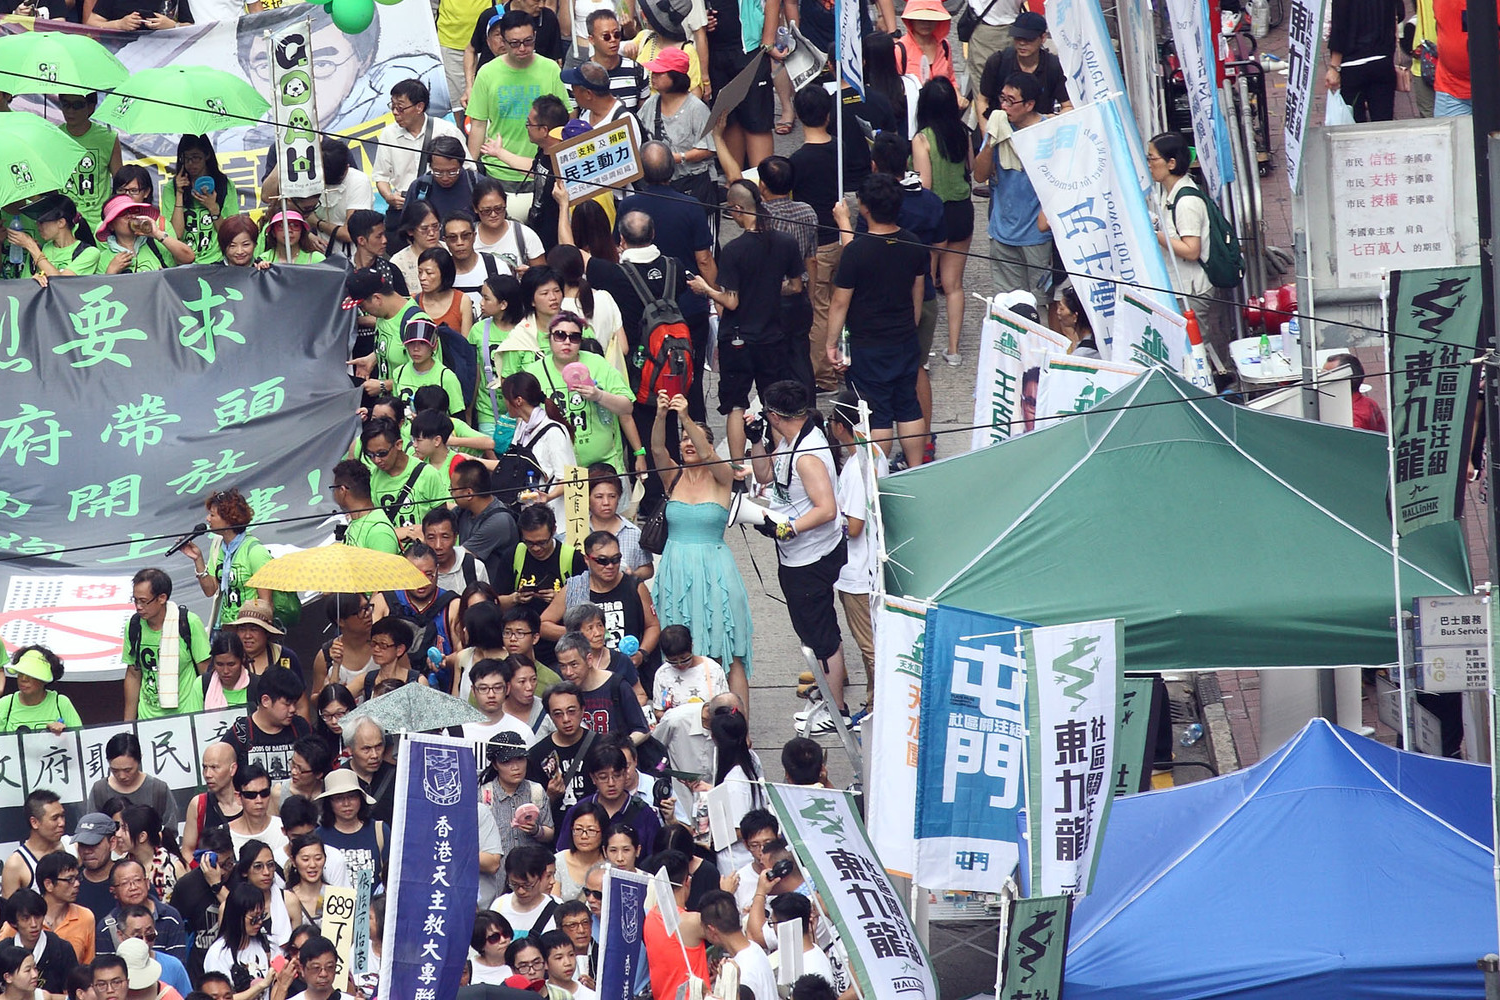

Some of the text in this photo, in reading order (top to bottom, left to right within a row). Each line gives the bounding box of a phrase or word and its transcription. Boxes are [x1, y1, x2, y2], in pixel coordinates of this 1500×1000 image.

[564, 147, 630, 184] 民主動力
[1345, 157, 1364, 168] 市民
[1369, 151, 1398, 166] 信任
[1346, 178, 1365, 189] 市民
[1370, 172, 1399, 188] 支持
[1347, 198, 1366, 209] 市民
[1370, 193, 1399, 208] 授權
[1349, 240, 1442, 257] 七百萬人 的期望
[1396, 350, 1434, 483] 東九龍
[1427, 344, 1462, 477] 社區關注組
[1440, 614, 1482, 626] 巴士服務
[1441, 627, 1488, 636] Bus Service
[942, 643, 1028, 810] 屯門
[1053, 719, 1088, 862] 東九龍
[326, 894, 355, 919] 689
[825, 847, 910, 960] 東九龍
